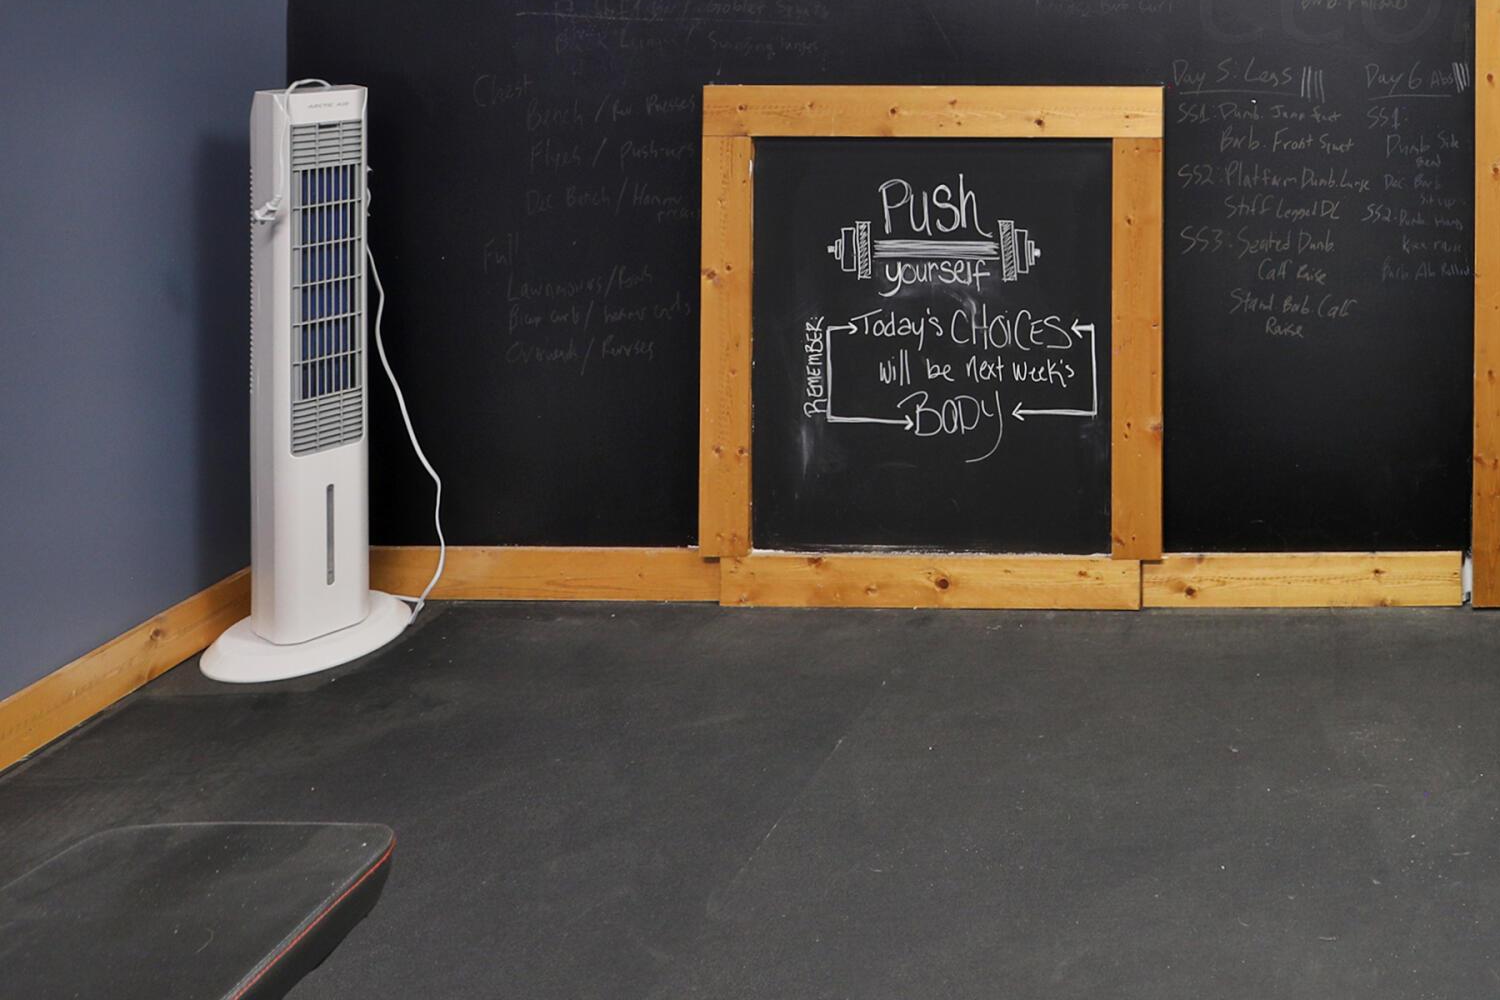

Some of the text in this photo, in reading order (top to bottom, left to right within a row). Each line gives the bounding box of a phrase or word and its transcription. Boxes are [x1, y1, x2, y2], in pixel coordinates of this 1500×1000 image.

[1171, 58, 1207, 95] Day
[1243, 55, 1293, 88] Legs
[1364, 62, 1405, 96] Day
[878, 173, 994, 239] Push
[877, 258, 991, 298] yourself
[850, 307, 944, 352] Today's
[926, 357, 956, 383] be
[896, 390, 1004, 463] BODY
